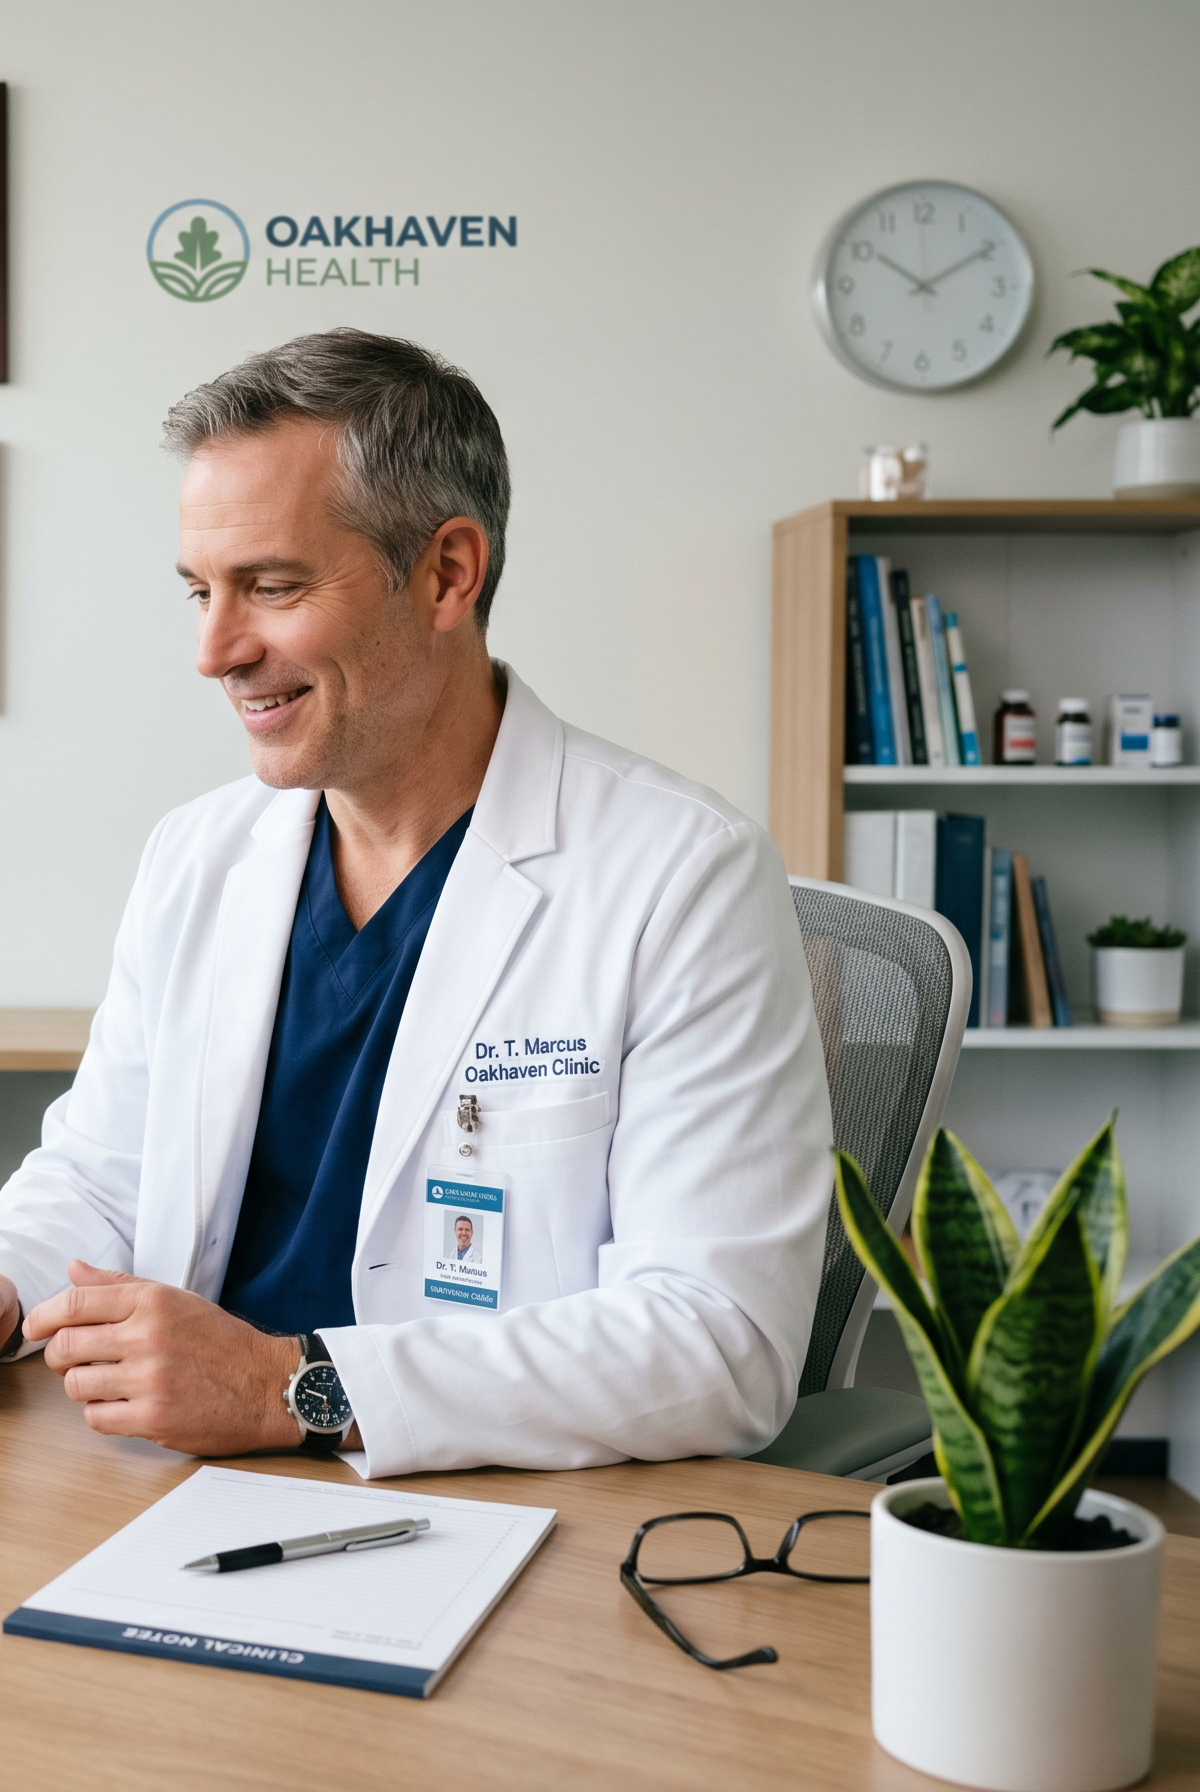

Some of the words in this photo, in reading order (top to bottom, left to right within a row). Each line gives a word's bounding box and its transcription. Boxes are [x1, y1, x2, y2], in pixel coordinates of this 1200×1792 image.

[914, 202, 935, 223] 12
[266, 215, 518, 247] OAKHAVEN
[880, 214, 895, 233] 11
[959, 214, 965, 233] 1
[852, 241, 873, 262] 10
[982, 240, 996, 261] 2
[267, 258, 420, 286] HEALTH
[838, 276, 854, 295] 9
[993, 276, 1005, 297] 3
[850, 315, 865, 336] 8
[980, 314, 994, 333] 4
[880, 341, 894, 360] 7
[953, 341, 967, 361] 5
[915, 352, 930, 372] 6
[475, 1042, 499, 1060] Dr.
[504, 1040, 519, 1057] T.
[525, 1037, 587, 1056] Marcus
[465, 1062, 547, 1083] Oakhaven
[552, 1057, 601, 1077] Clinic
[436, 1261, 447, 1271] Dr.
[204, 1639, 305, 1664] CLINICAL
